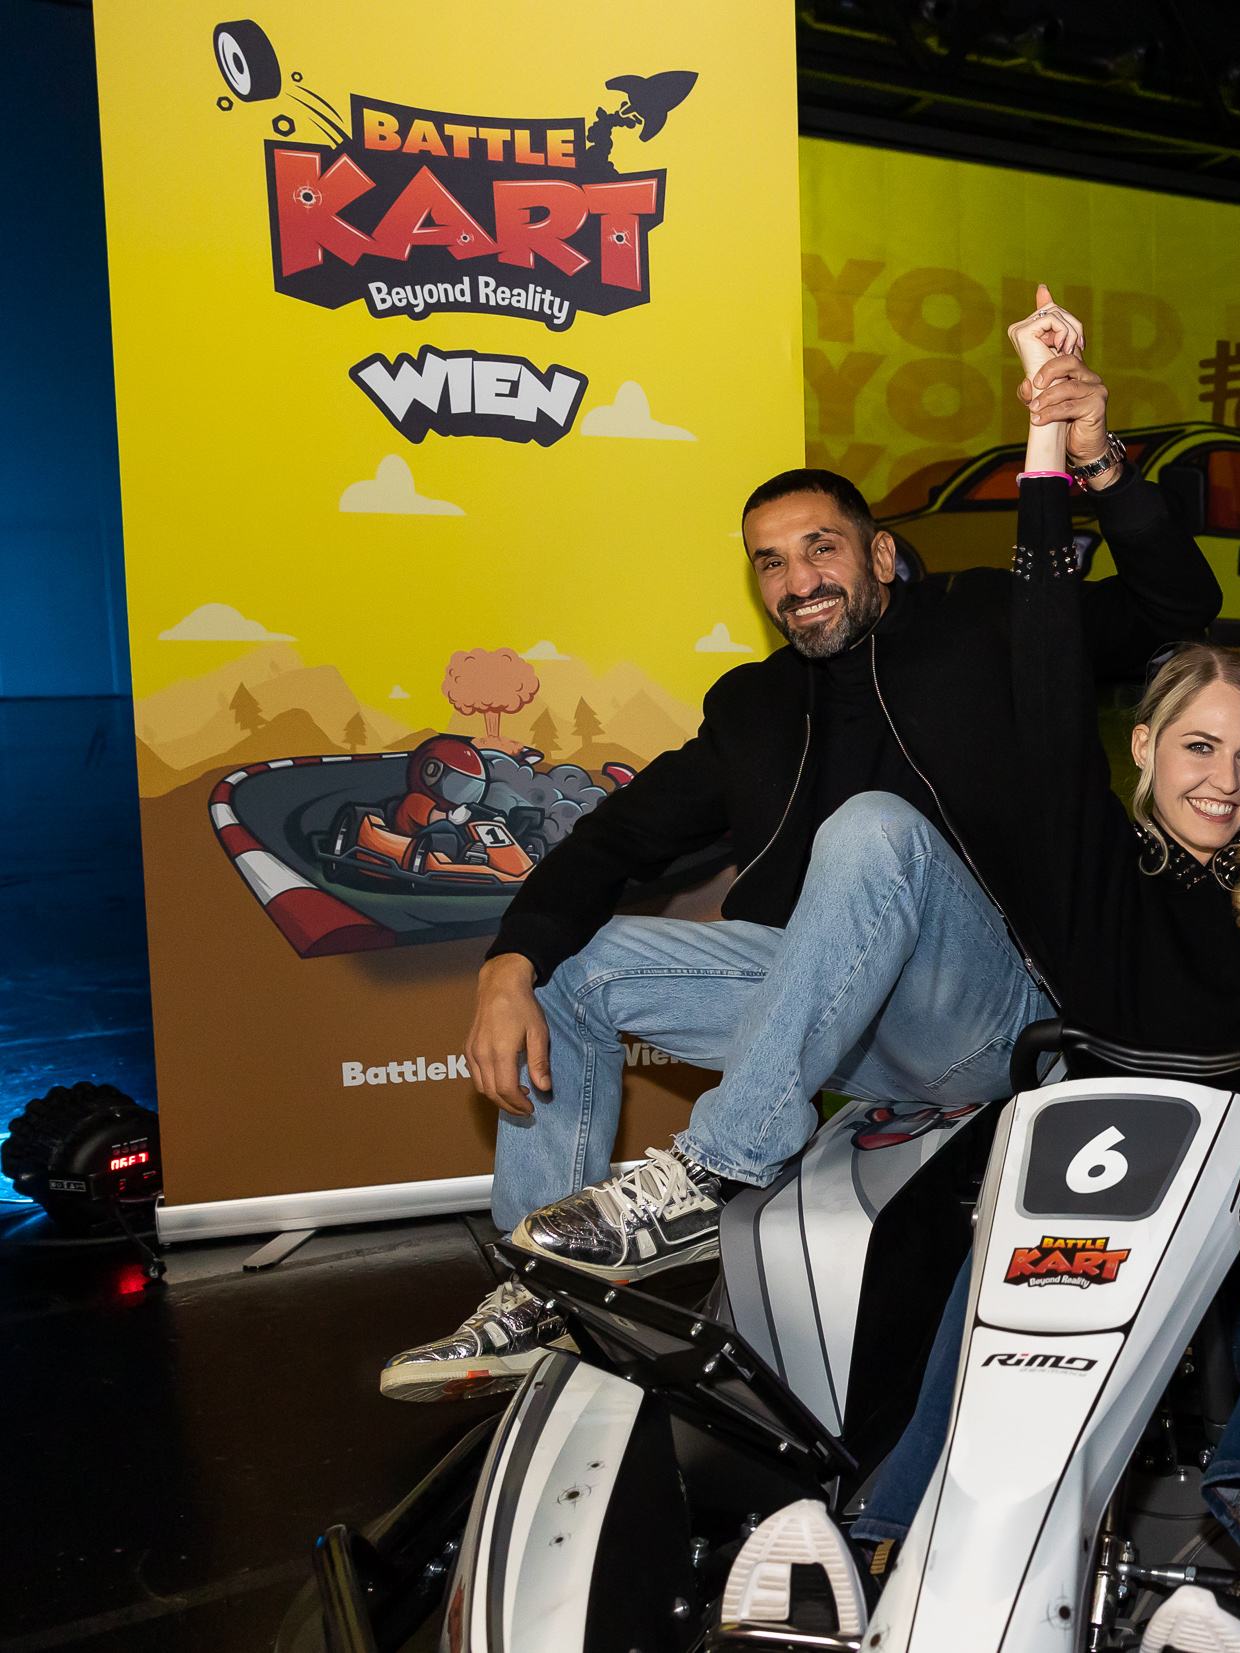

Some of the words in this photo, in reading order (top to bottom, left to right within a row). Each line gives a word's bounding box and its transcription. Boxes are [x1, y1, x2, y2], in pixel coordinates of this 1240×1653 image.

[363, 108, 576, 168] BATTLE
[273, 148, 658, 291] KART
[368, 276, 471, 313] Beyond
[478, 275, 570, 325] Reality
[358, 352, 580, 427] WIEN
[485, 827, 506, 844] 1
[1065, 1125, 1128, 1194] 6
[1006, 1248, 1129, 1280] KART
[1042, 1237, 1106, 1250] BATTLE
[1029, 1275, 1061, 1287] Beyond
[1061, 1275, 1091, 1289] Reality
